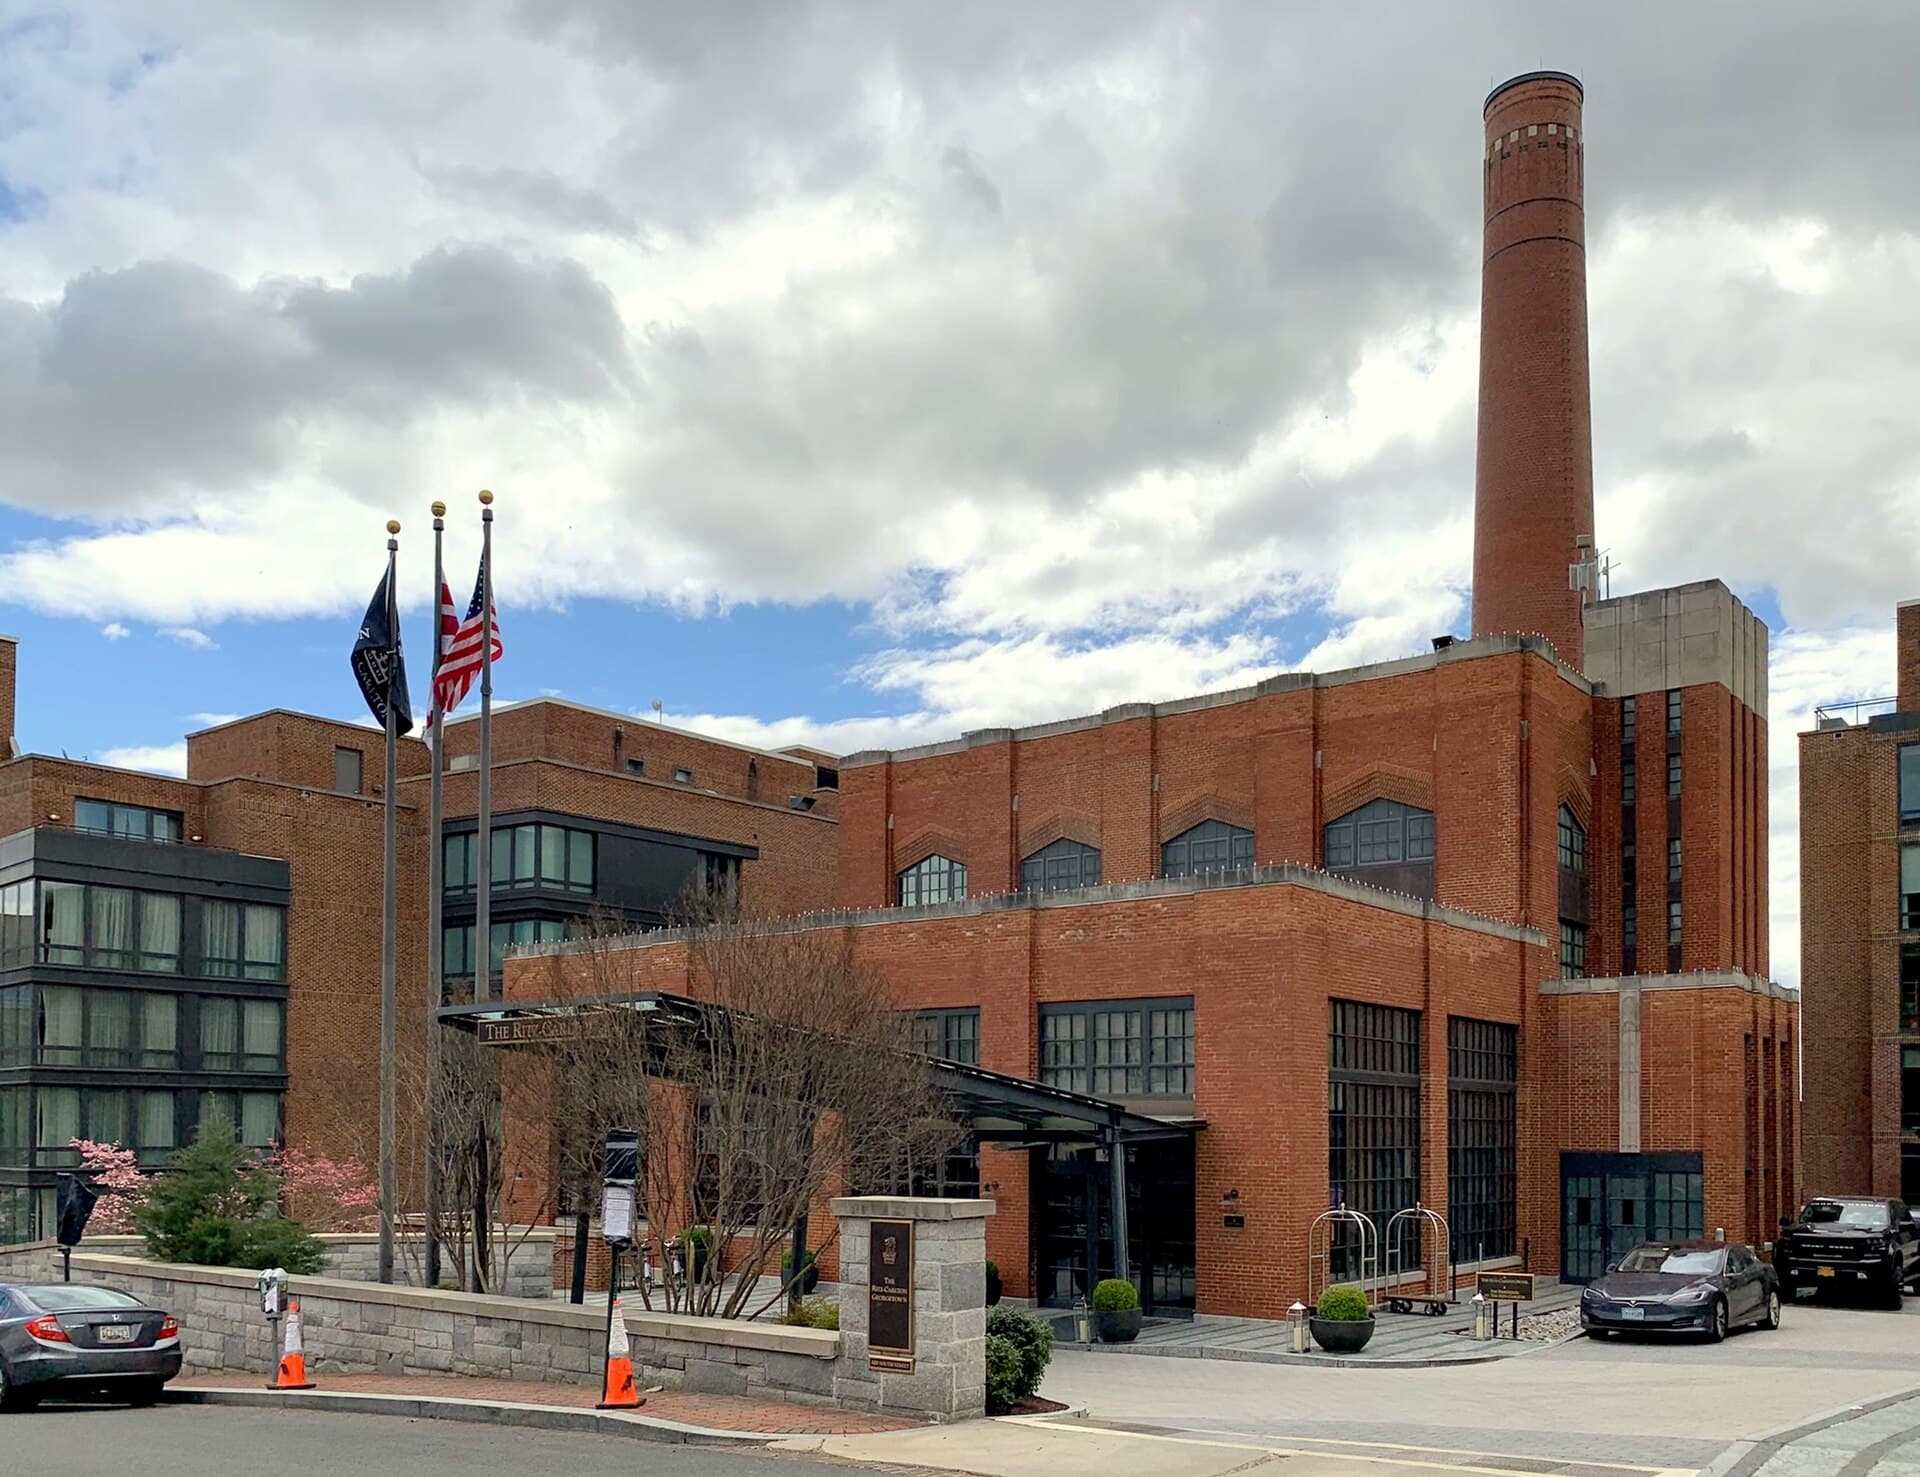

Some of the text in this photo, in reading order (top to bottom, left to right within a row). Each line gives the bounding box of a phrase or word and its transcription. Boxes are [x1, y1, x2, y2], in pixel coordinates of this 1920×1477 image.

[485, 1023, 510, 1040] THE
[883, 1277, 895, 1285] THE
[871, 1293, 907, 1303] GEORGETOWN
